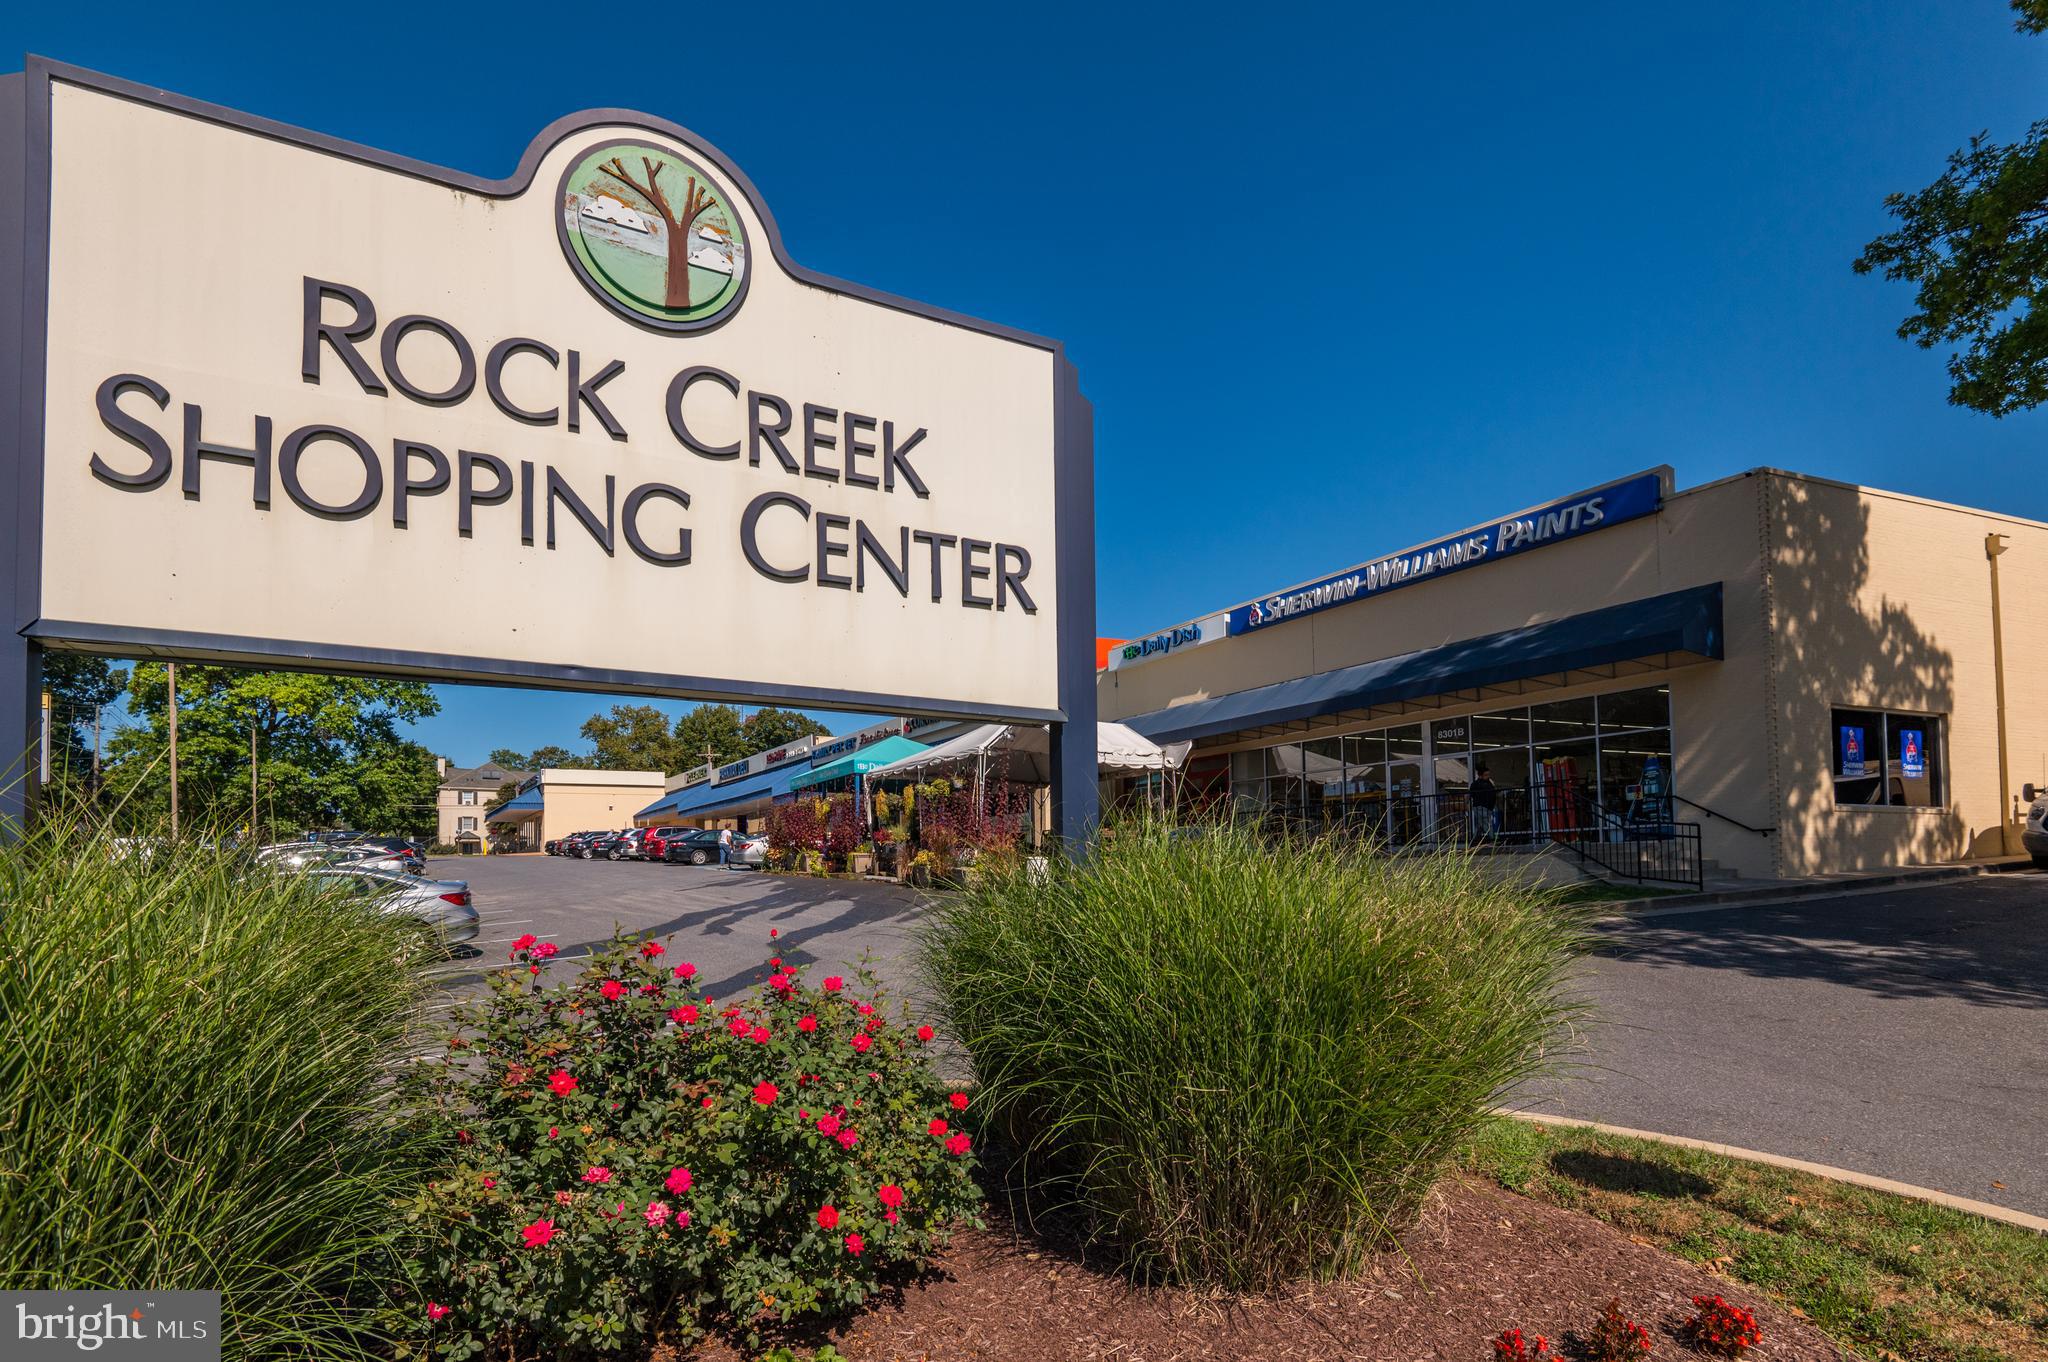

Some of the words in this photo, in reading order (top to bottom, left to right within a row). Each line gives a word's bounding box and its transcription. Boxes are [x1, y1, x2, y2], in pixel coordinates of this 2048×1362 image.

[302, 276, 628, 443] ROCK
[666, 366, 930, 499] CREEK
[89, 374, 692, 567] SHOPPING
[740, 492, 1038, 616] CENTER
[1264, 534, 1489, 622] SHERWIN-WILLIAMS
[1496, 497, 1605, 552] PAINTS
[1140, 634, 1171, 657] Daily
[1170, 623, 1202, 647] Dish
[1437, 727, 1464, 739] 8301B
